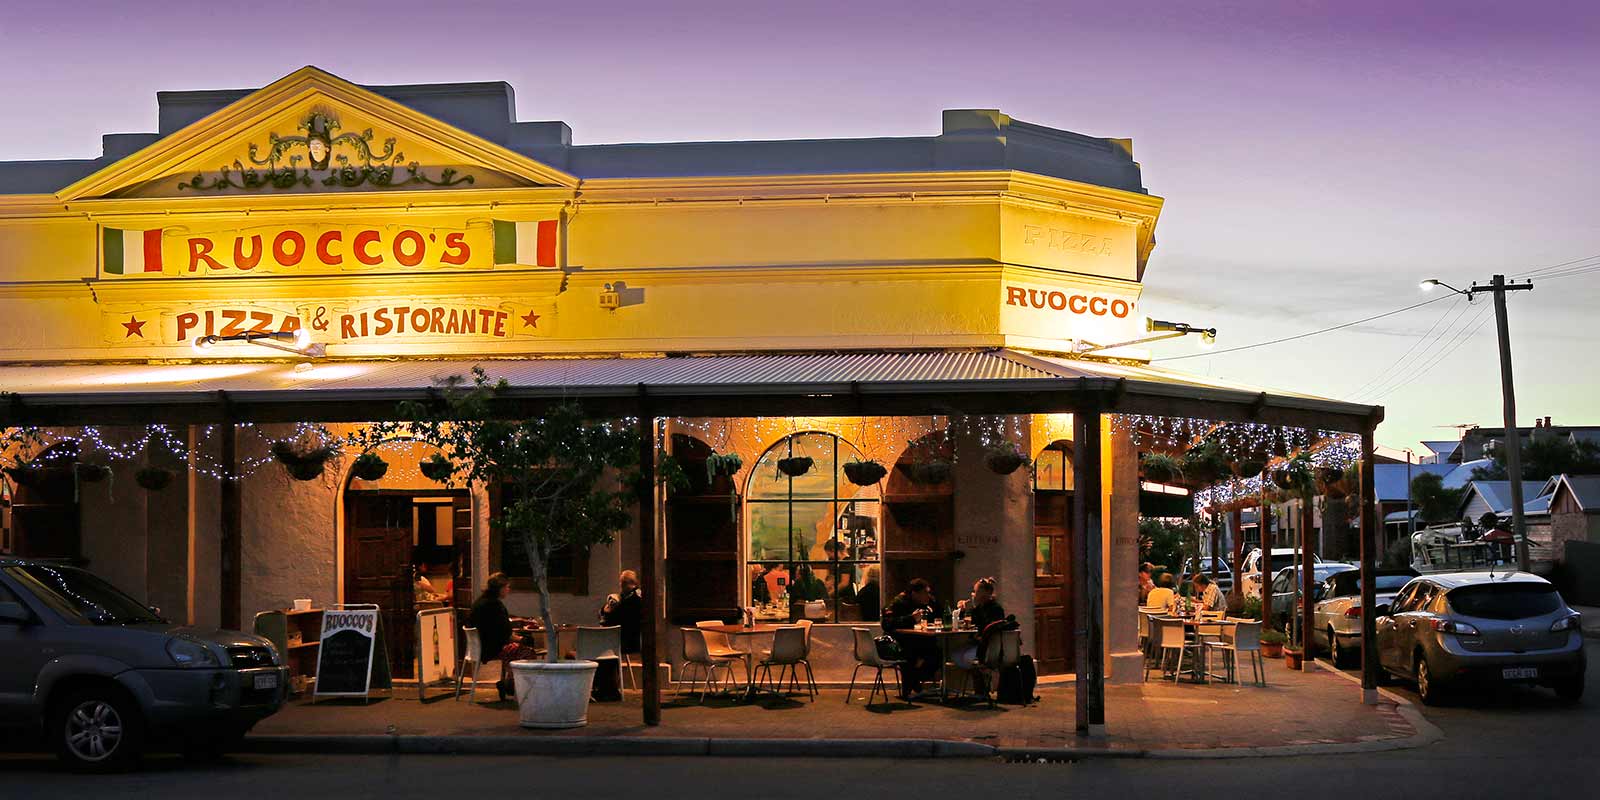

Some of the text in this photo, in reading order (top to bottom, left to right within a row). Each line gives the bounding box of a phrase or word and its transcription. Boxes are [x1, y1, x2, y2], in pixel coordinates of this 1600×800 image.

[187, 230, 471, 272] RUOCCO'S
[1024, 225, 1113, 257] PIZZA
[176, 306, 508, 341] PIZZA & RISTORANTE
[324, 614, 373, 633] RUOCCO'S
